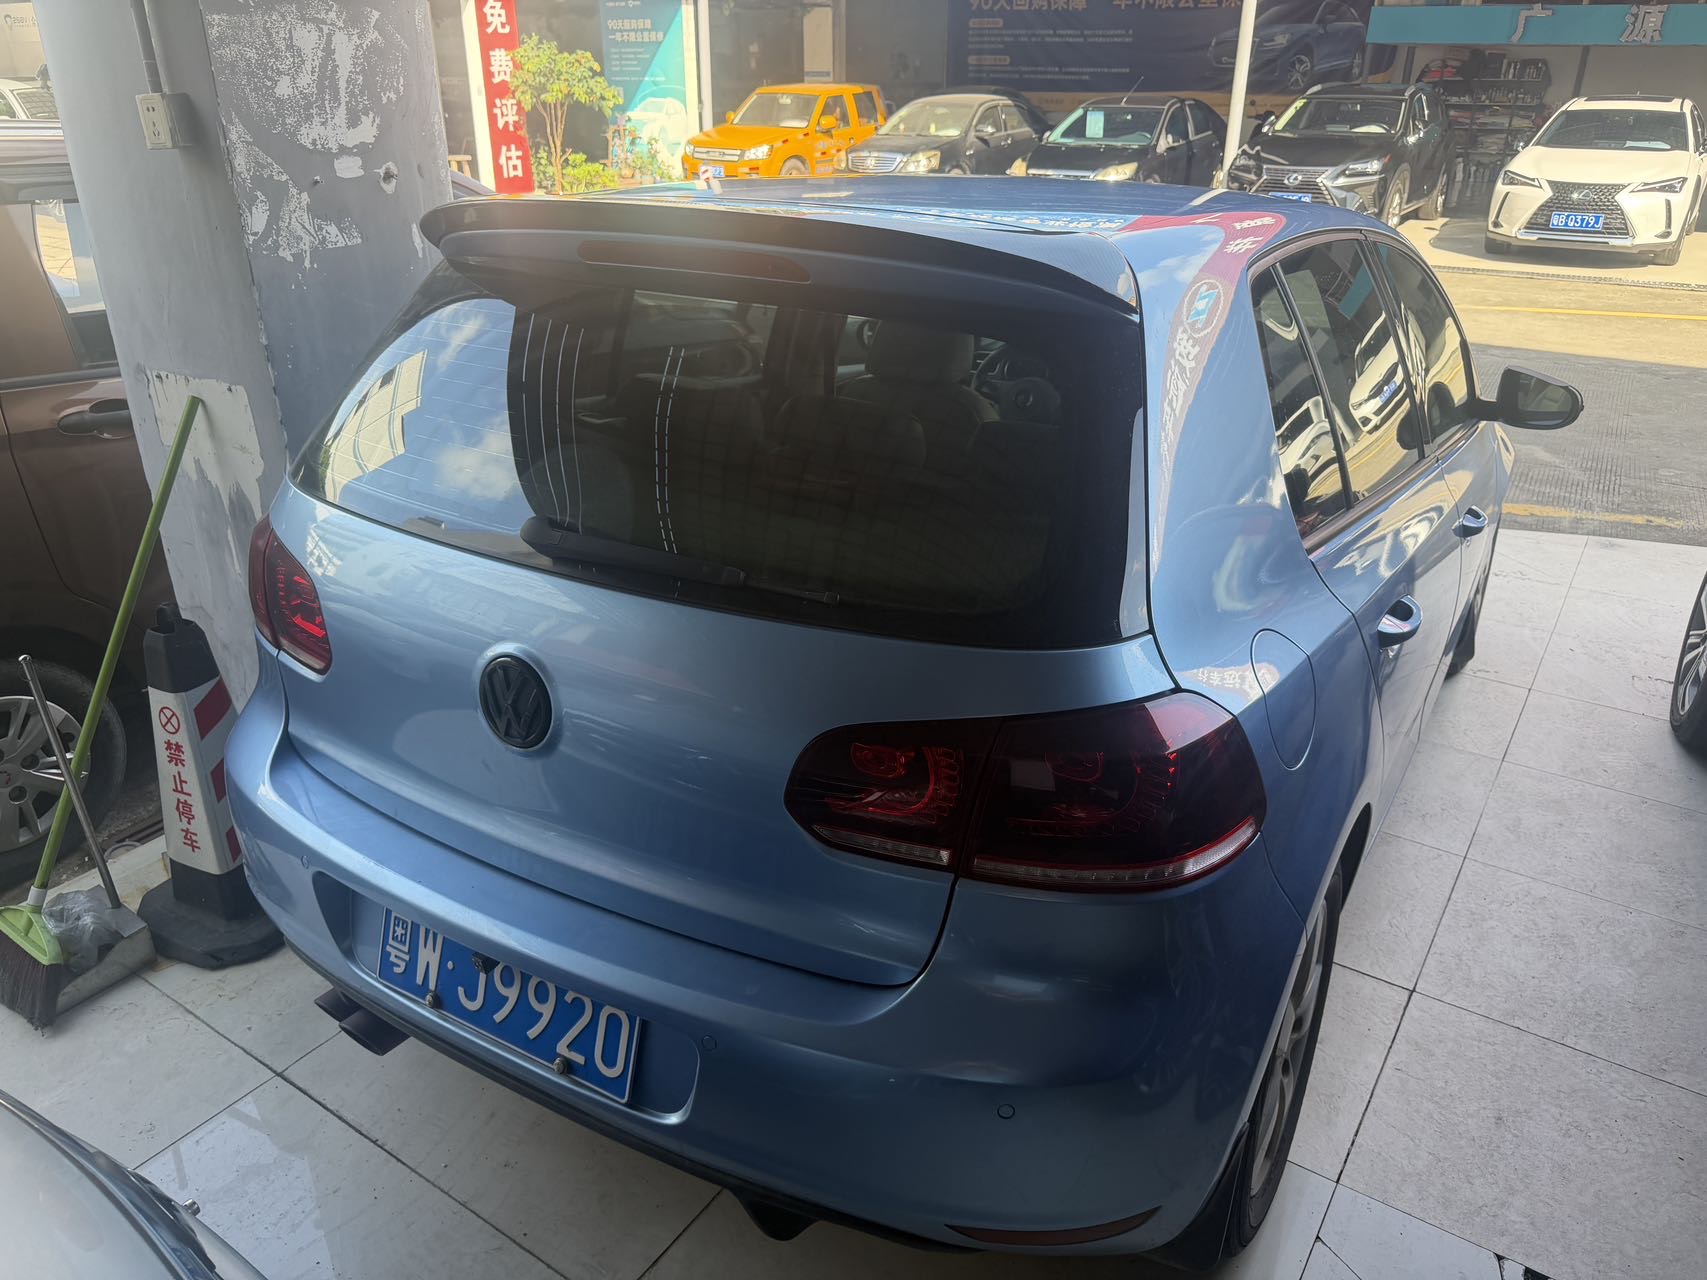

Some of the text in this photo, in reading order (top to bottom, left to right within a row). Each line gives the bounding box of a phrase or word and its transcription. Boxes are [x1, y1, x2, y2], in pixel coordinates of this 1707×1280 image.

[1510, 3, 1670, 43] 广源
[483, 0, 524, 179] 免费评估
[164, 739, 201, 853] 禁止停车
